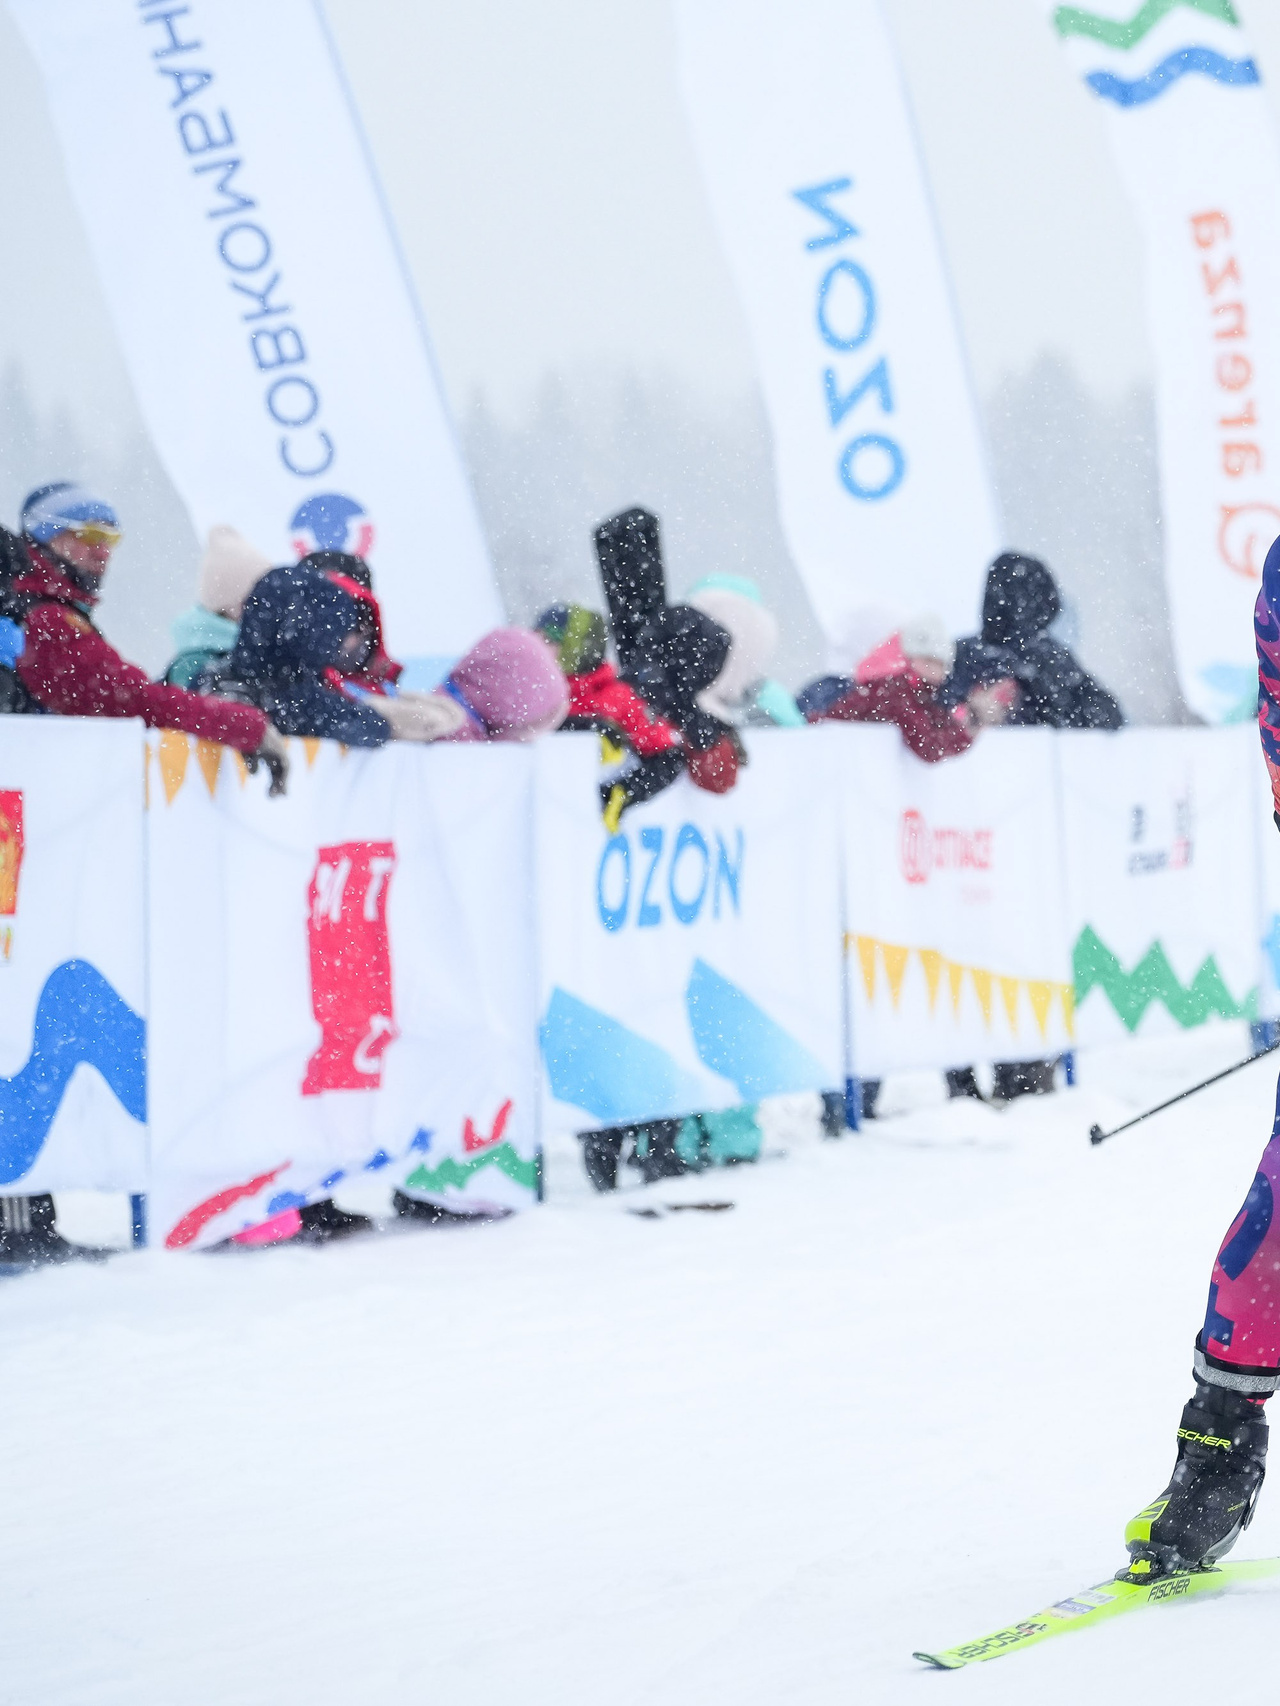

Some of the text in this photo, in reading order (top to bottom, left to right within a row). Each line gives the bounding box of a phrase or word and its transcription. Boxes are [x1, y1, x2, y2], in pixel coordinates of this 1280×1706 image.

[595, 822, 746, 934] OZON
[1176, 1427, 1232, 1449] SCHER
[1147, 1578, 1191, 1603] FISCHER
